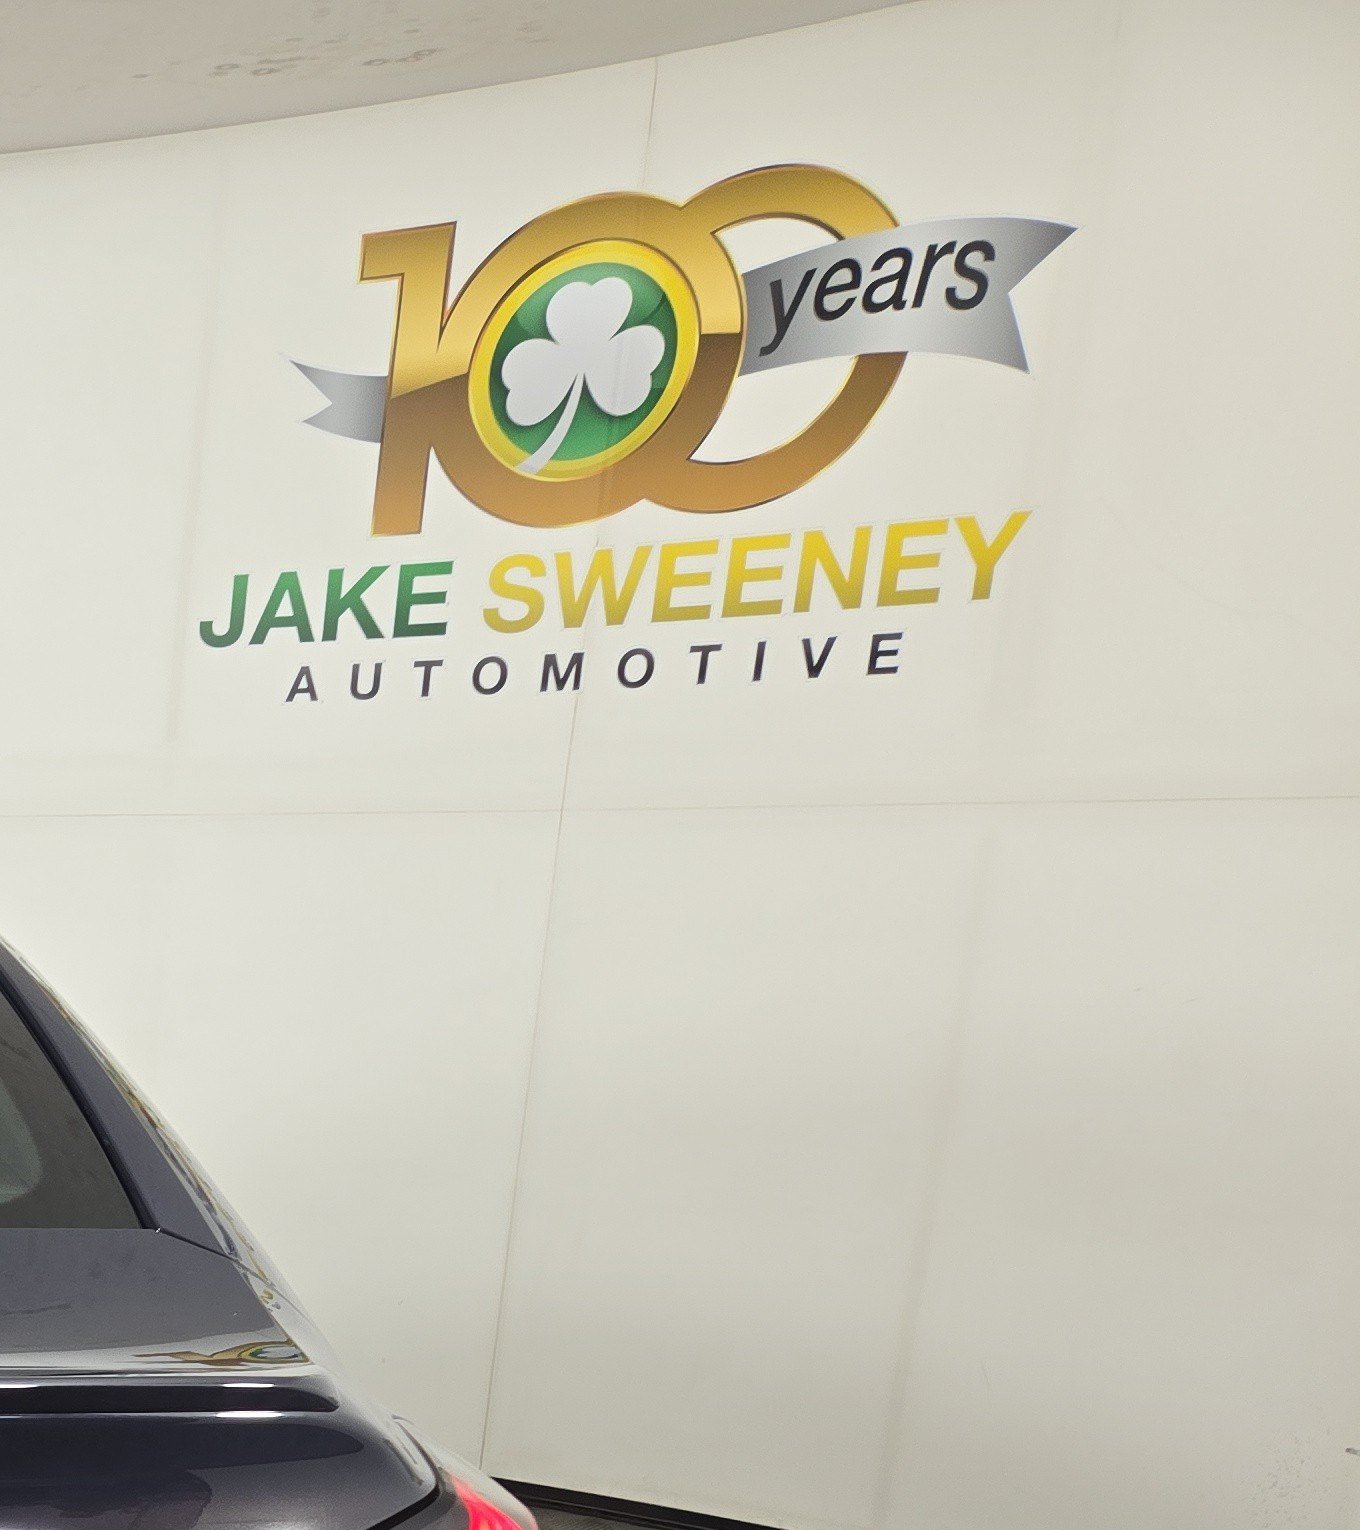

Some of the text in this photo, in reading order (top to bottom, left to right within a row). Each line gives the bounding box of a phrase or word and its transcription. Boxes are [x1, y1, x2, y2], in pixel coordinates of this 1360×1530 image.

[359, 164, 996, 537] 100 years
[199, 510, 1033, 649] JAKE SWEENEY
[285, 631, 905, 703] AUTOMOTIVE
